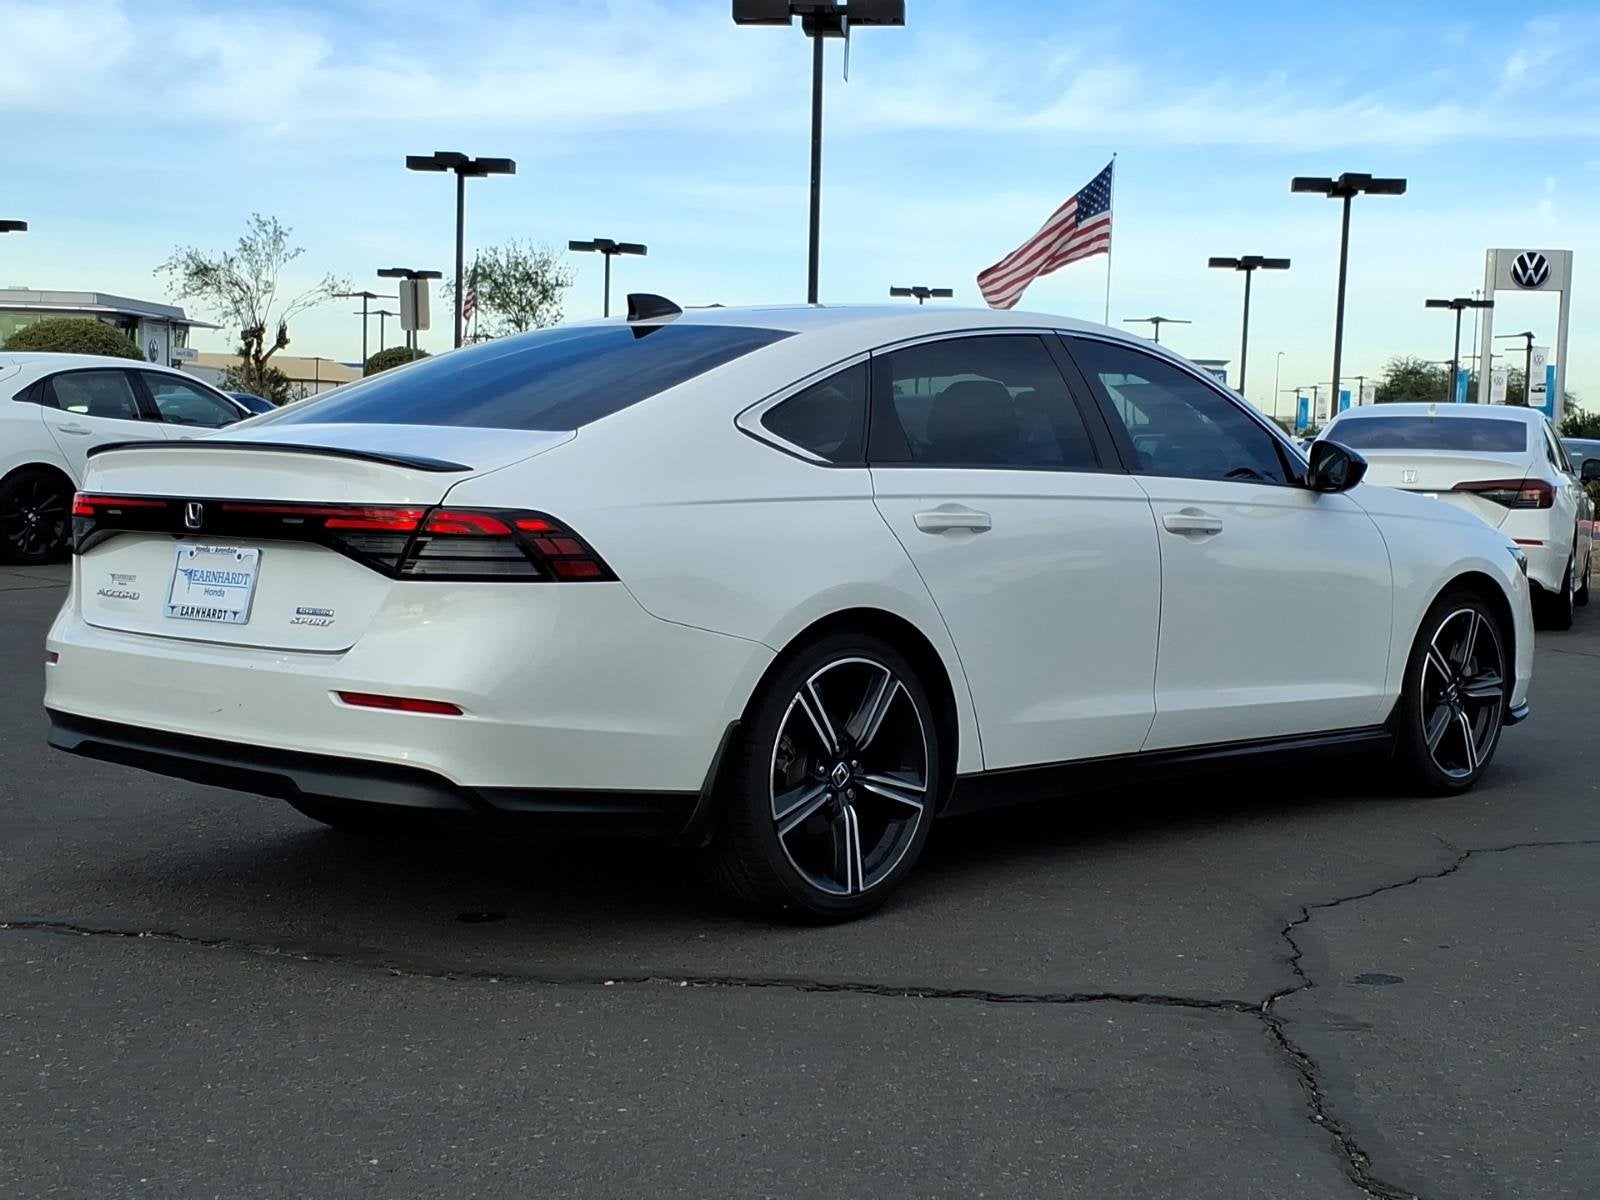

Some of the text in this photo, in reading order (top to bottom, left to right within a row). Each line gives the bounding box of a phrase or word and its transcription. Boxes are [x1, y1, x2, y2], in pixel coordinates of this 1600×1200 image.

[195, 545, 211, 553] Honda
[192, 569, 250, 586] EARNHARDT
[203, 587, 225, 598] Honda
[180, 605, 228, 620] EARNHARDT
[290, 616, 335, 627] SPORT
